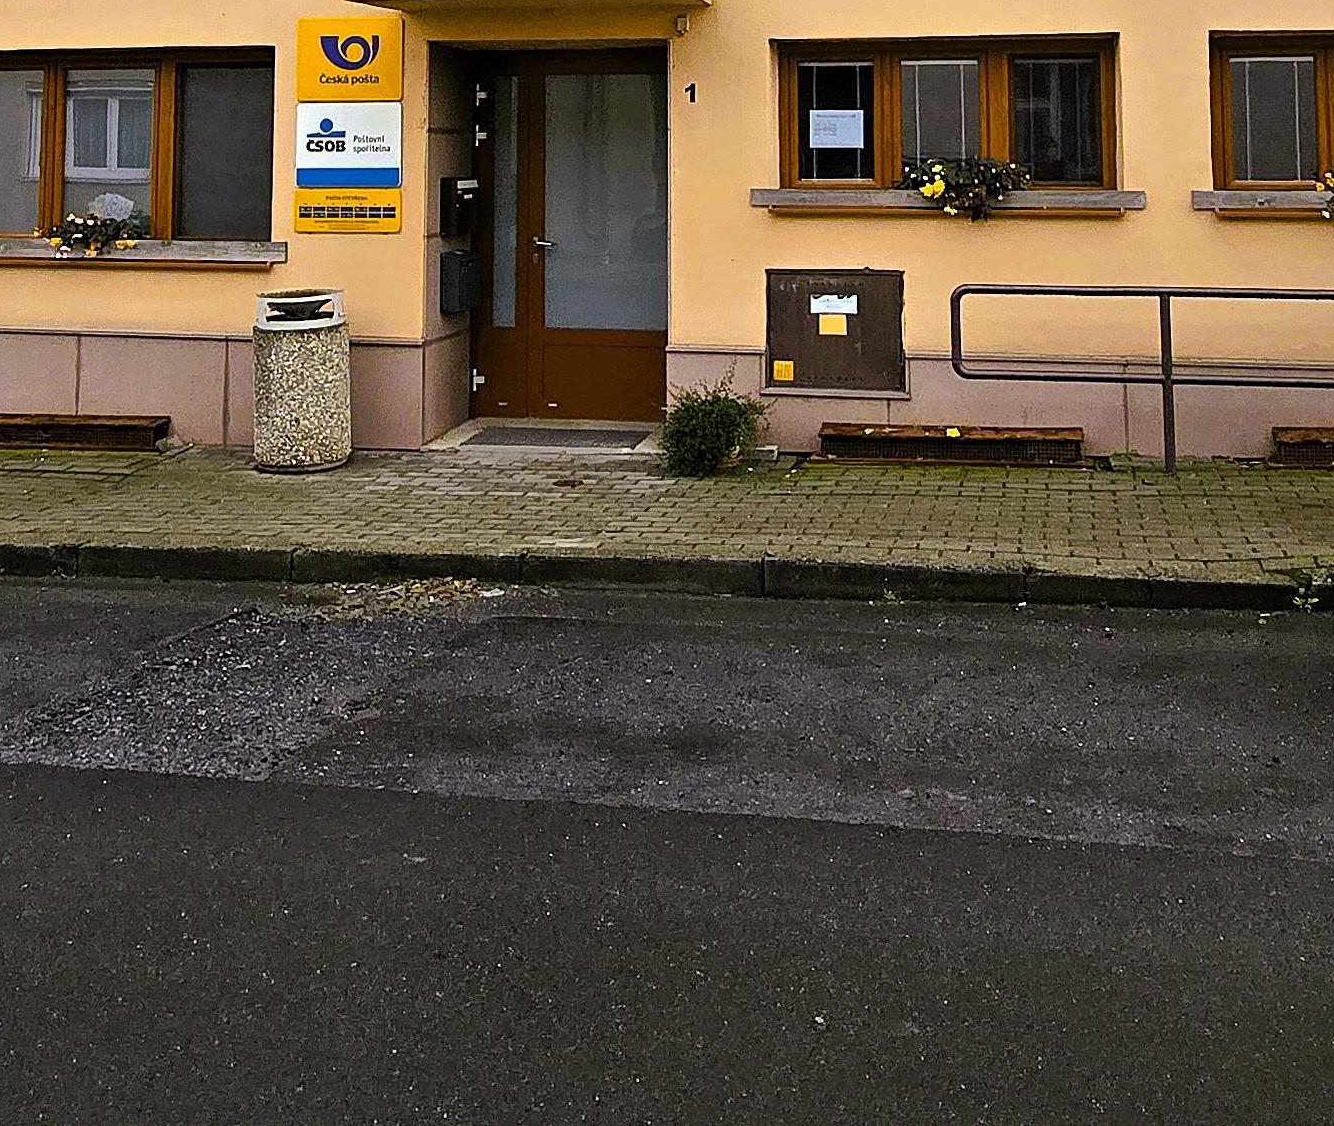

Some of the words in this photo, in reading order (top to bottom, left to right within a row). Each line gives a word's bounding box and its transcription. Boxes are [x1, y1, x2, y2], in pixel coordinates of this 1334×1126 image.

[319, 74, 349, 84] Česká
[351, 74, 380, 85] pošta
[685, 83, 696, 103] 1
[306, 139, 346, 153] ČSOB
